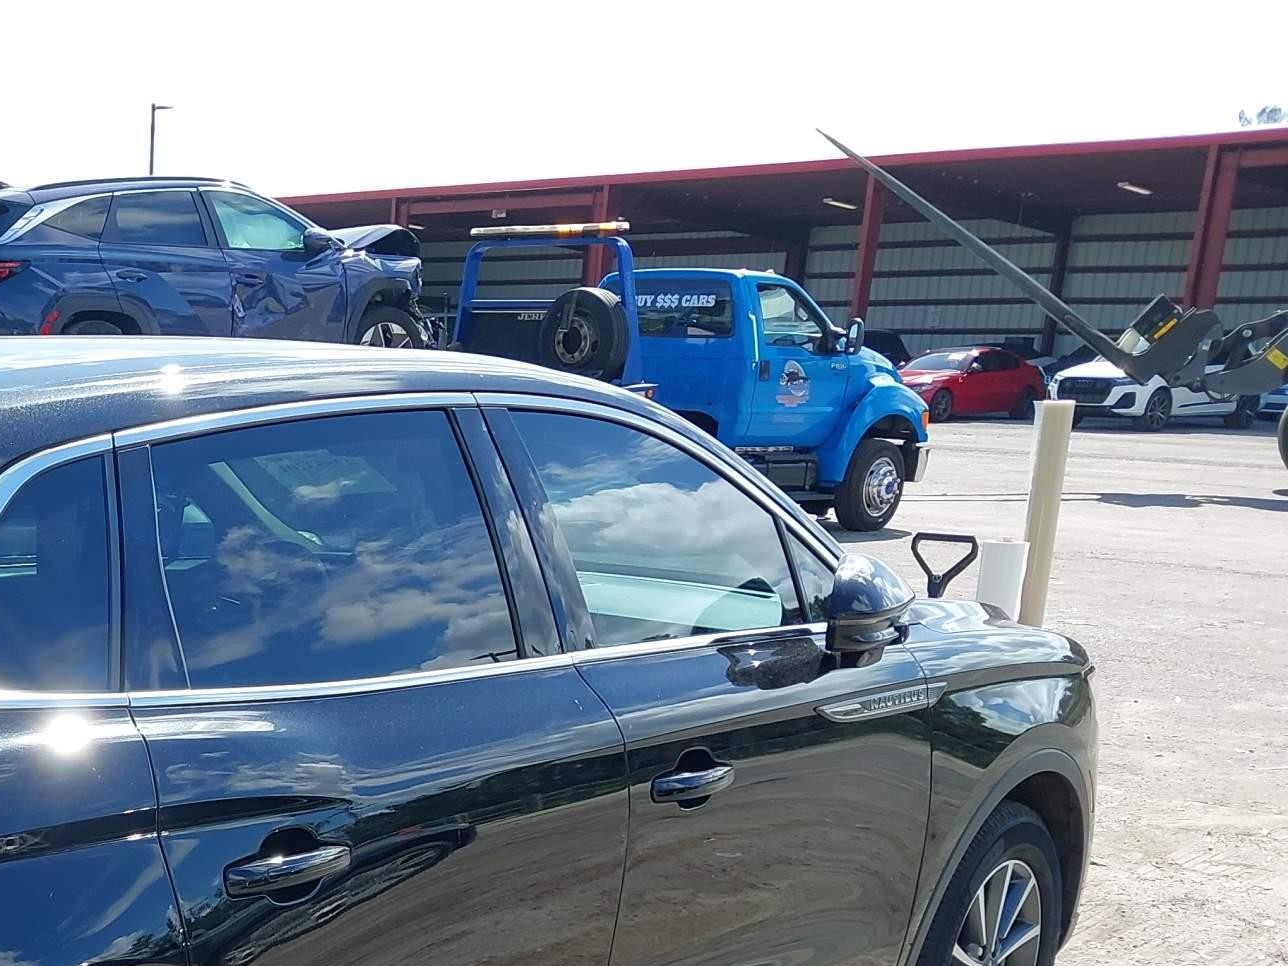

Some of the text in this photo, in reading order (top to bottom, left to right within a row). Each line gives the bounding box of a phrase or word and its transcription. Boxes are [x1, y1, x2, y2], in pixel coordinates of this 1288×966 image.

[655, 293, 680, 308] $$$
[681, 294, 716, 307] CARS
[870, 687, 925, 711] NAUTILUS
